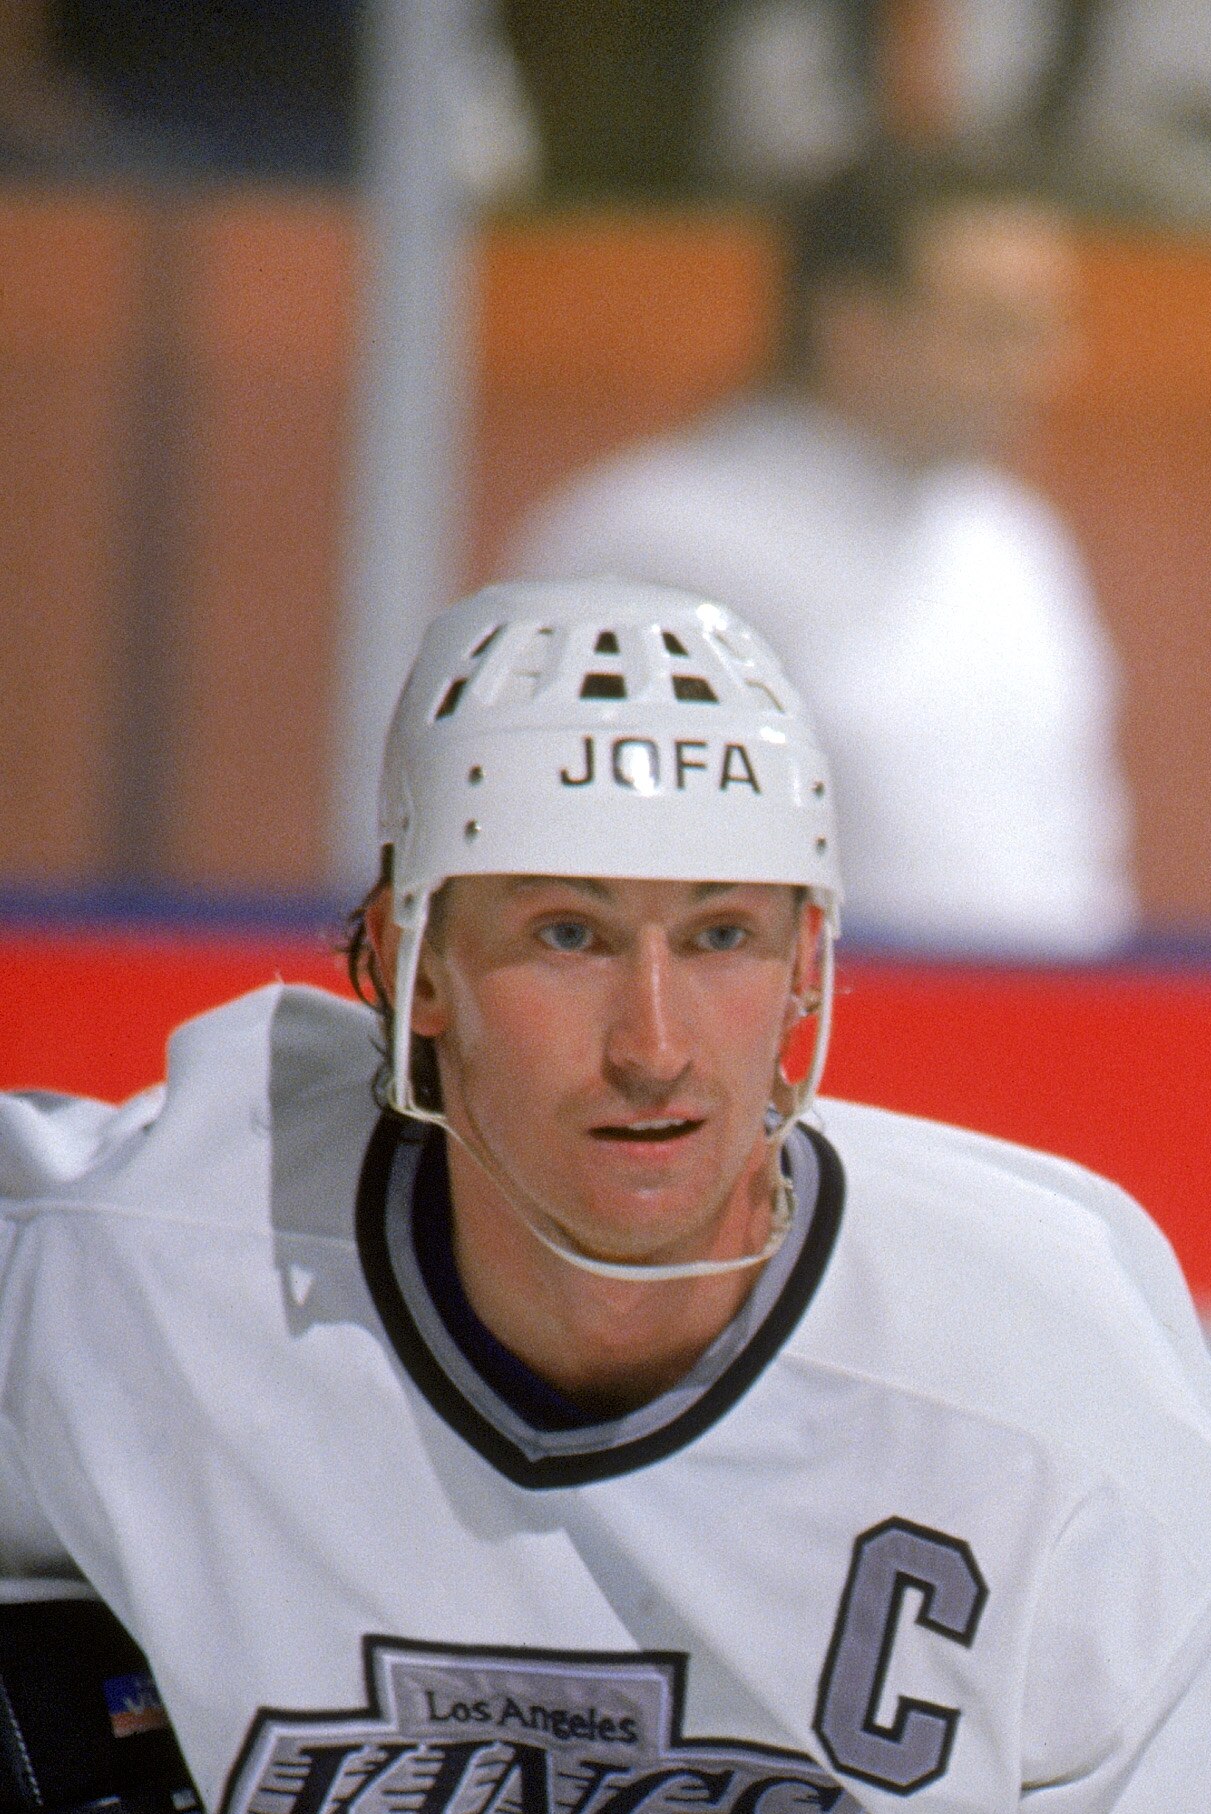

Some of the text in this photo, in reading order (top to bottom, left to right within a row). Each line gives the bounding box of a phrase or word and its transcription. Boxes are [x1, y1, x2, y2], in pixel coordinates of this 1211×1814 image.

[559, 735, 763, 797] JOFA
[813, 1515, 989, 1796] C
[424, 1689, 639, 1744] Los Angeles
